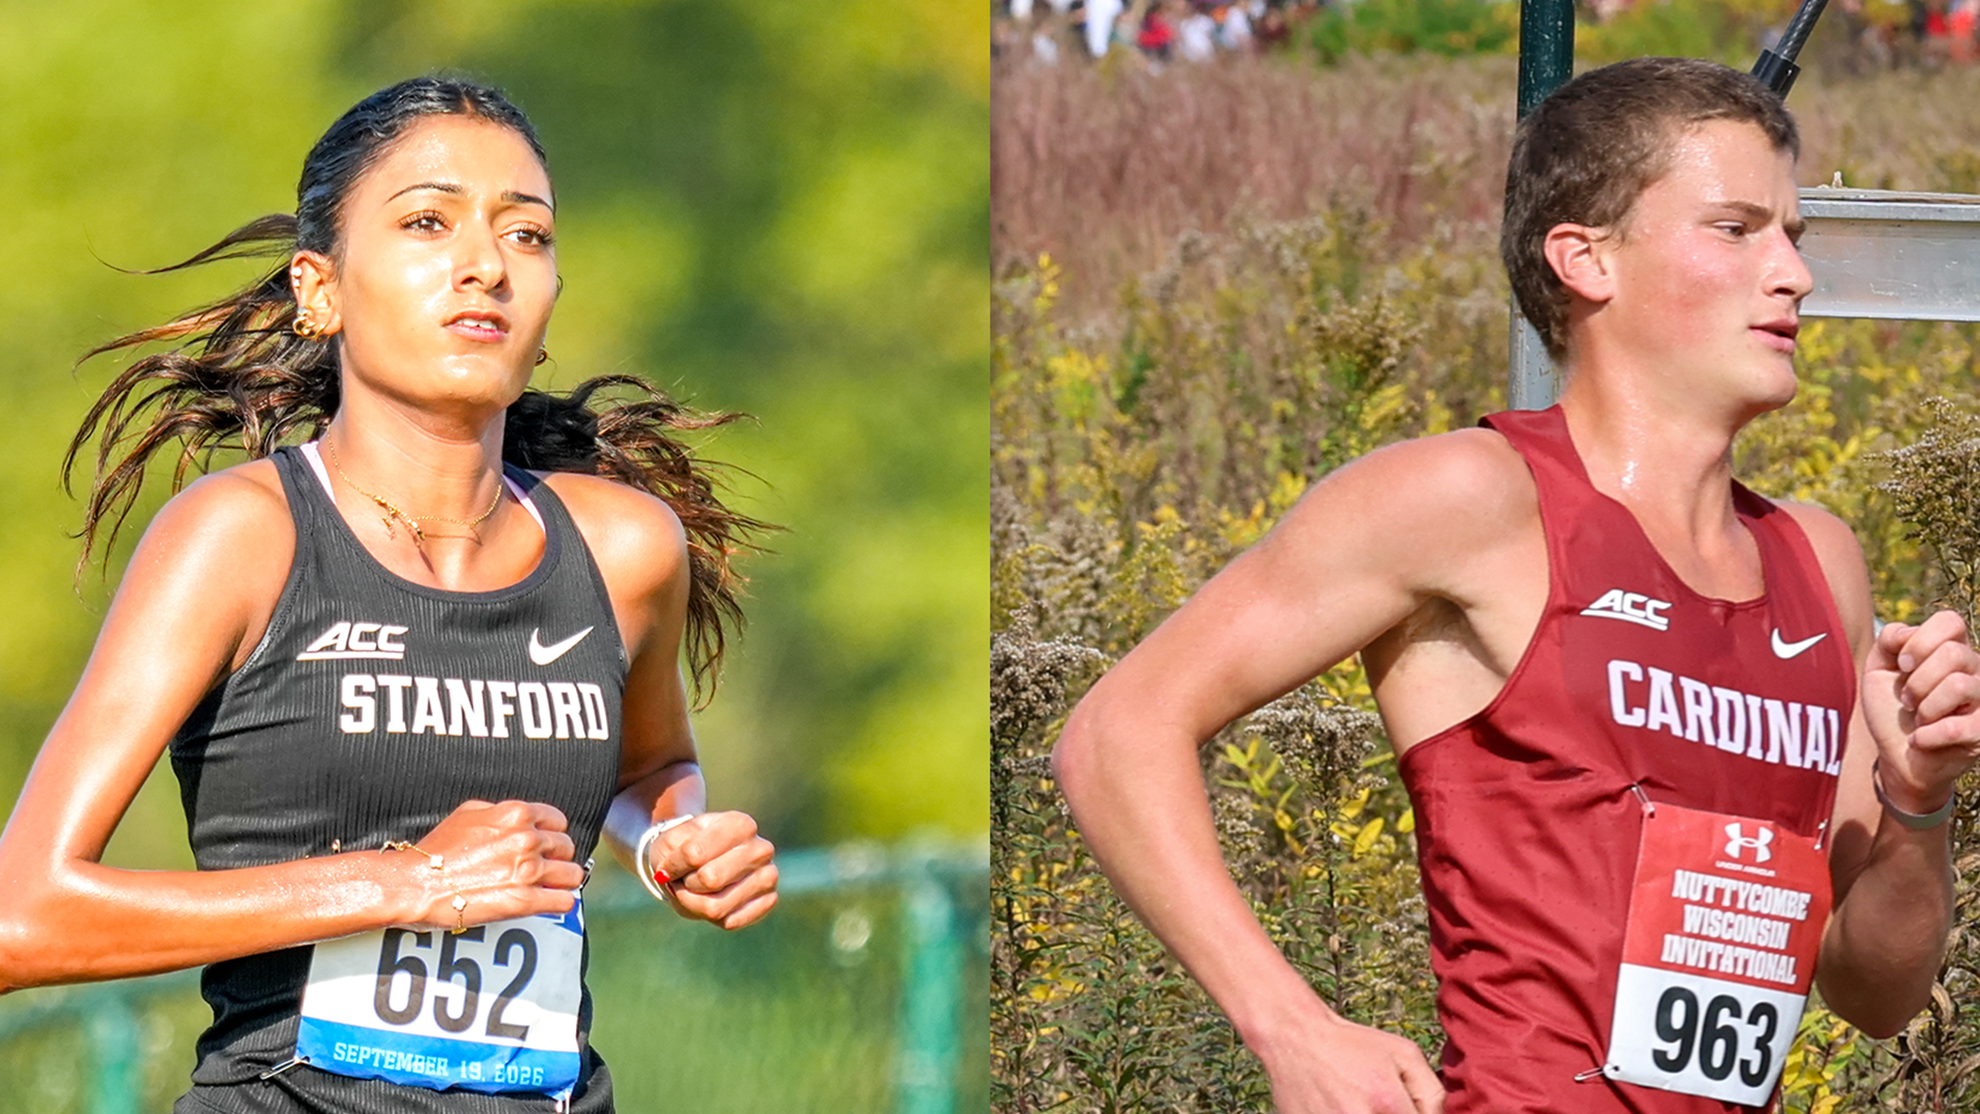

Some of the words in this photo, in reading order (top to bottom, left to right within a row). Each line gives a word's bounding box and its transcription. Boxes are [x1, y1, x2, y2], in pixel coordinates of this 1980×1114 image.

[1588, 589, 1672, 625] ACC
[305, 621, 408, 652] ACC
[340, 674, 609, 740] STANFORD
[1607, 659, 1841, 776] CARDINAL
[1671, 869, 1812, 920] NUTTYCOMBE
[1683, 904, 1791, 950] WISCONSIN
[373, 926, 538, 1042] 652
[1660, 933, 1797, 985] INVITATIONAL
[1652, 986, 1778, 1088] 963
[333, 1042, 449, 1077] SEPTEMBER
[494, 1064, 544, 1086] 2026
